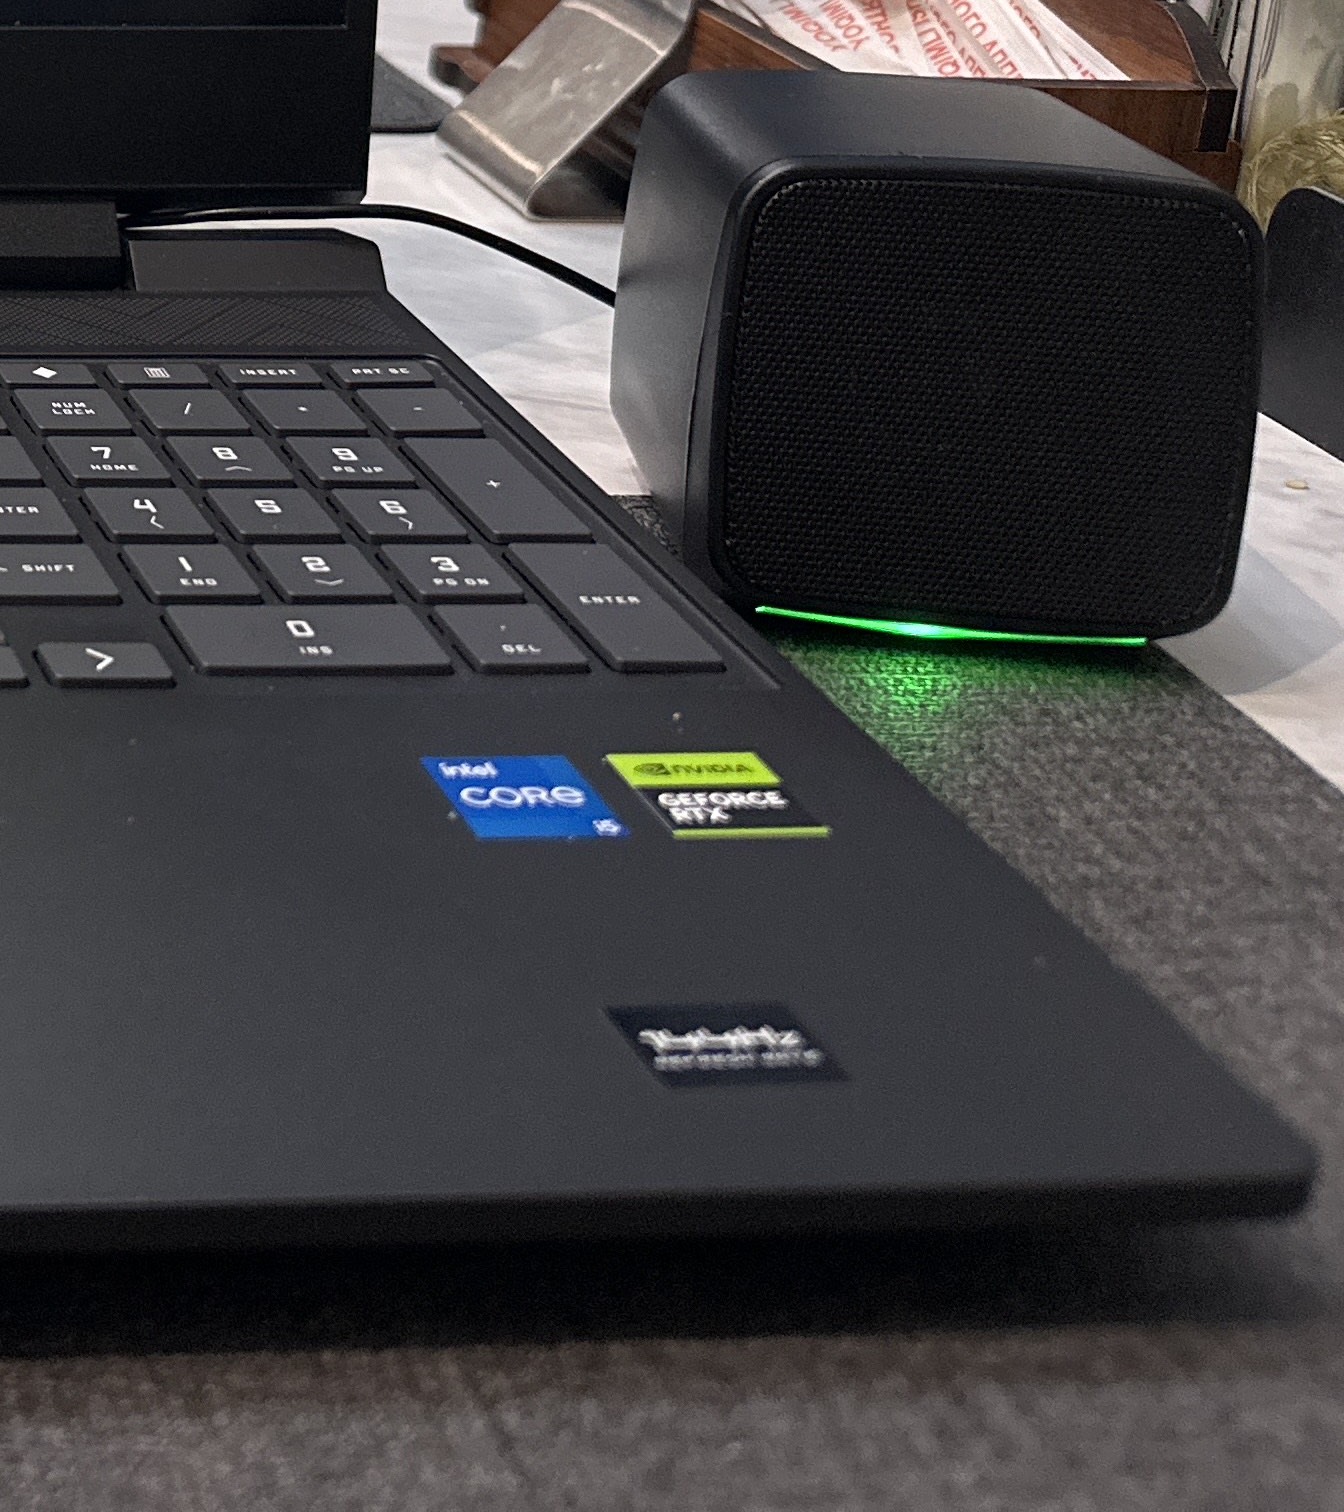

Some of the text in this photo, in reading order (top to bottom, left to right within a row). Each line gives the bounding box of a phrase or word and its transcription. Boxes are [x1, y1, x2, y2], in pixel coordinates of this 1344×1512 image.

[239, 368, 296, 376] INSERT
[90, 446, 112, 459] 7
[212, 447, 238, 460] 8
[331, 447, 359, 461] 9
[133, 498, 158, 513] 4
[254, 499, 282, 514] 5
[379, 500, 407, 515] 6
[21, 564, 74, 572] SHIFT
[301, 556, 331, 572] 2
[430, 556, 460, 572] 3
[179, 578, 218, 586] END
[579, 595, 641, 604] ENTER
[299, 645, 333, 655] INS
[501, 644, 541, 654] DEL
[438, 761, 498, 780] intel
[659, 789, 788, 810] GEFORCE
[670, 806, 732, 824] RTX
